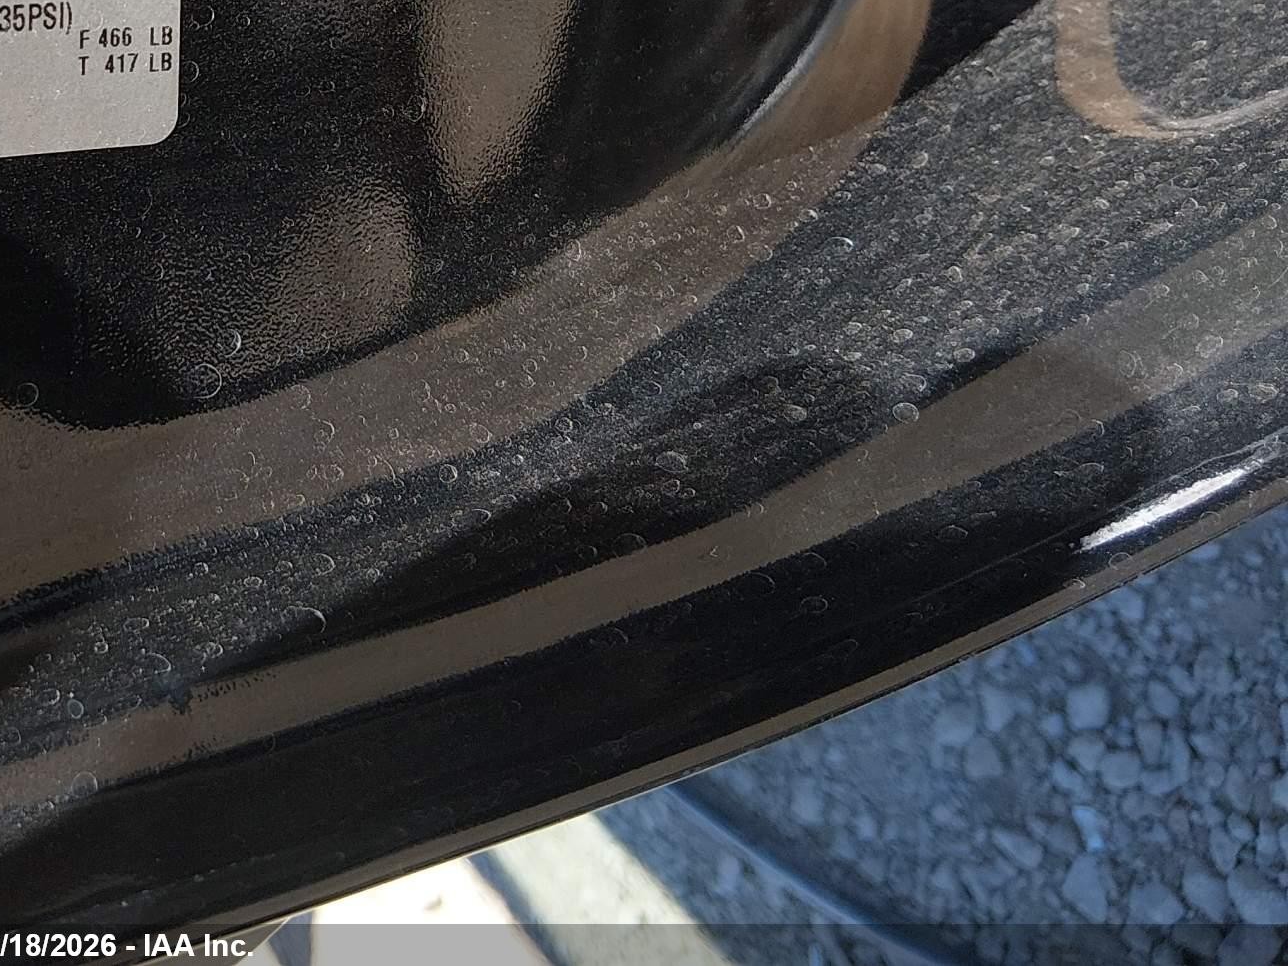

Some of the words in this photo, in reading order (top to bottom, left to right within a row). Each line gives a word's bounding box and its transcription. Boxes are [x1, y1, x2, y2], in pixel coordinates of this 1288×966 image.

[79, 29, 90, 49] F
[98, 27, 132, 48] 466
[149, 26, 173, 47] LB
[78, 55, 89, 76] T
[104, 53, 137, 74] 417
[149, 51, 173, 72] LB
